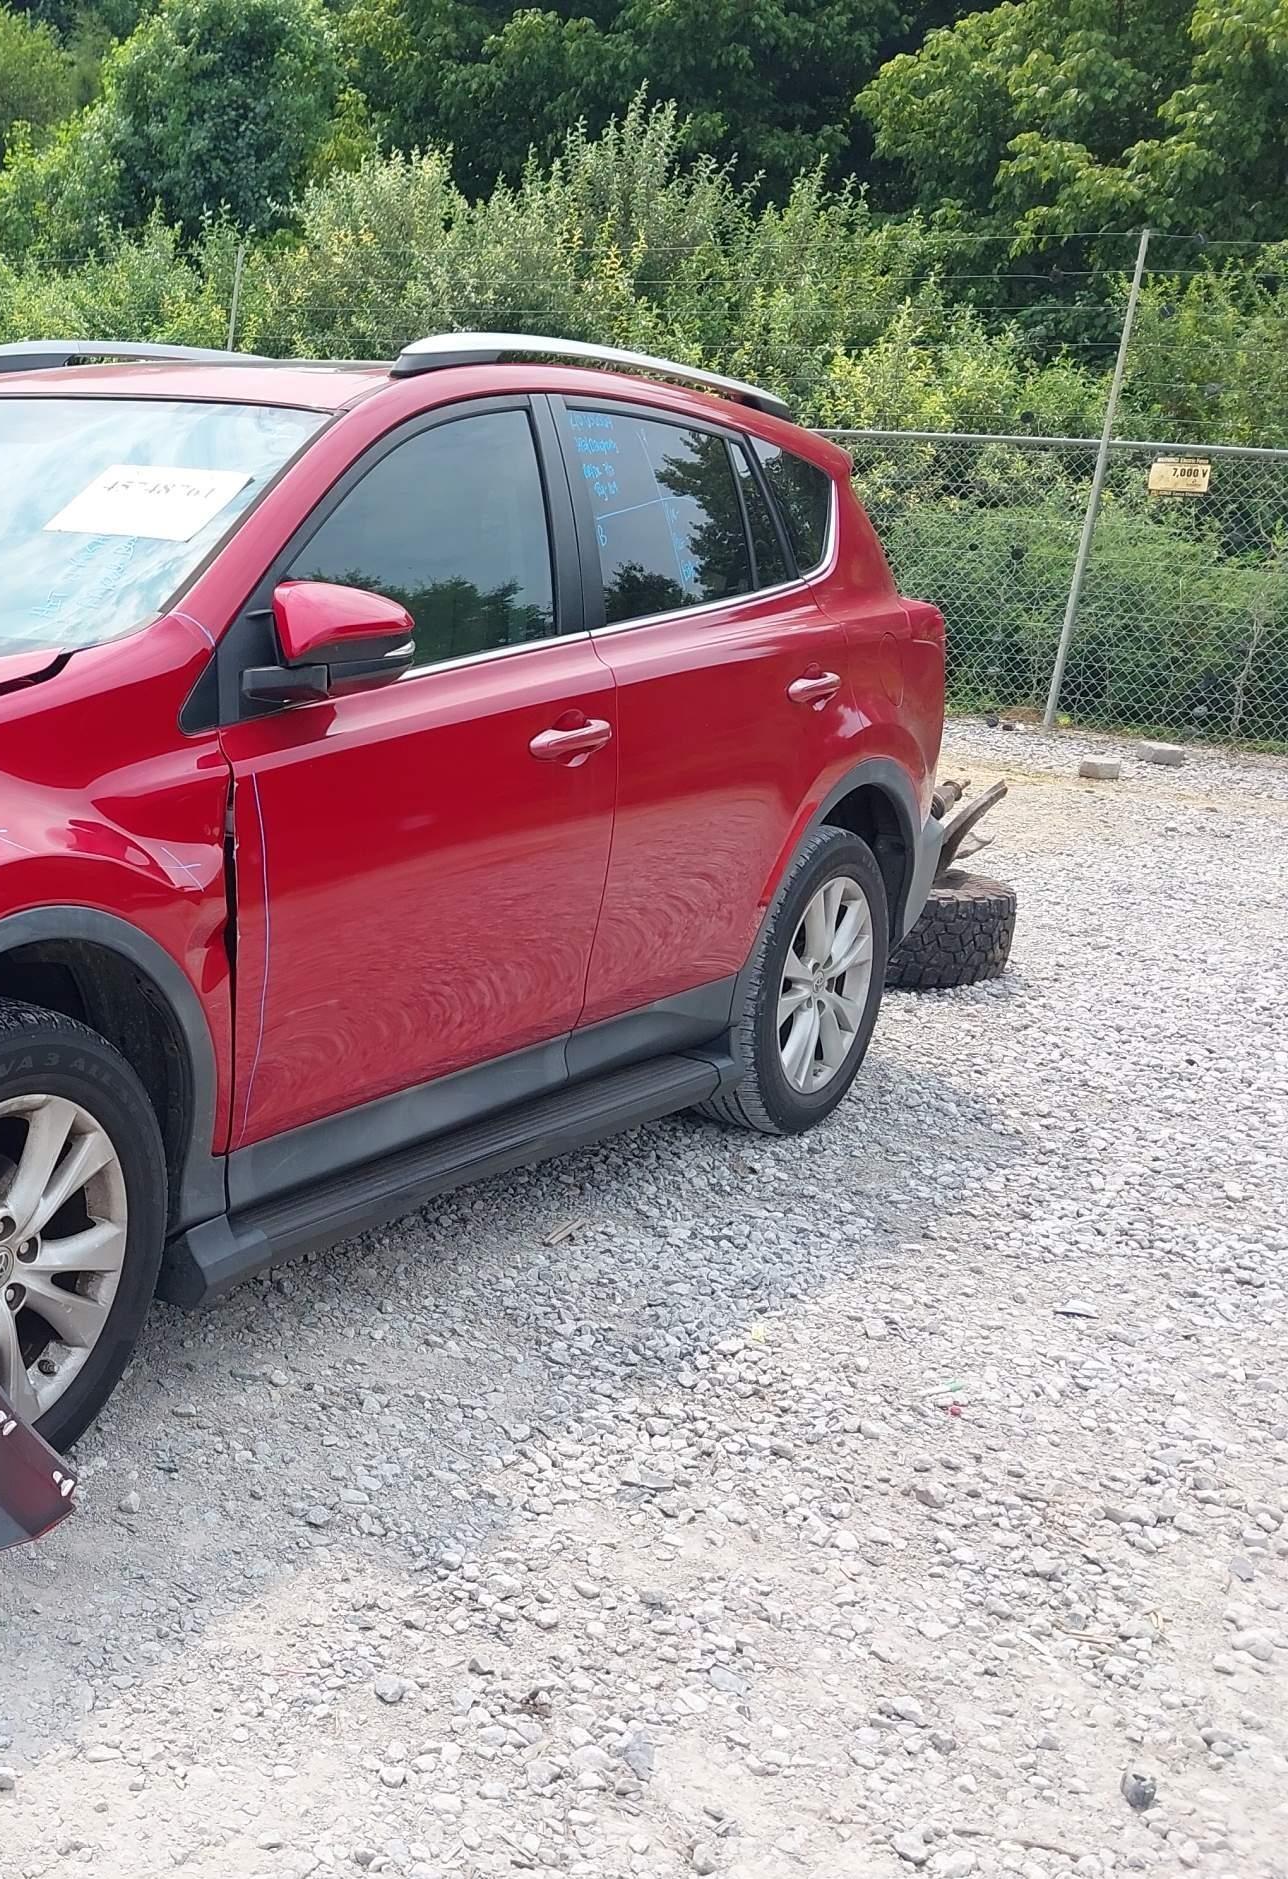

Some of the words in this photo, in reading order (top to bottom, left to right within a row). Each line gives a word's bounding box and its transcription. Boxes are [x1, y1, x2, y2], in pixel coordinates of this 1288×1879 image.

[1172, 467, 1199, 478] 7,000
[1201, 468, 1208, 478] V
[44, 1052, 61, 1066] 3
